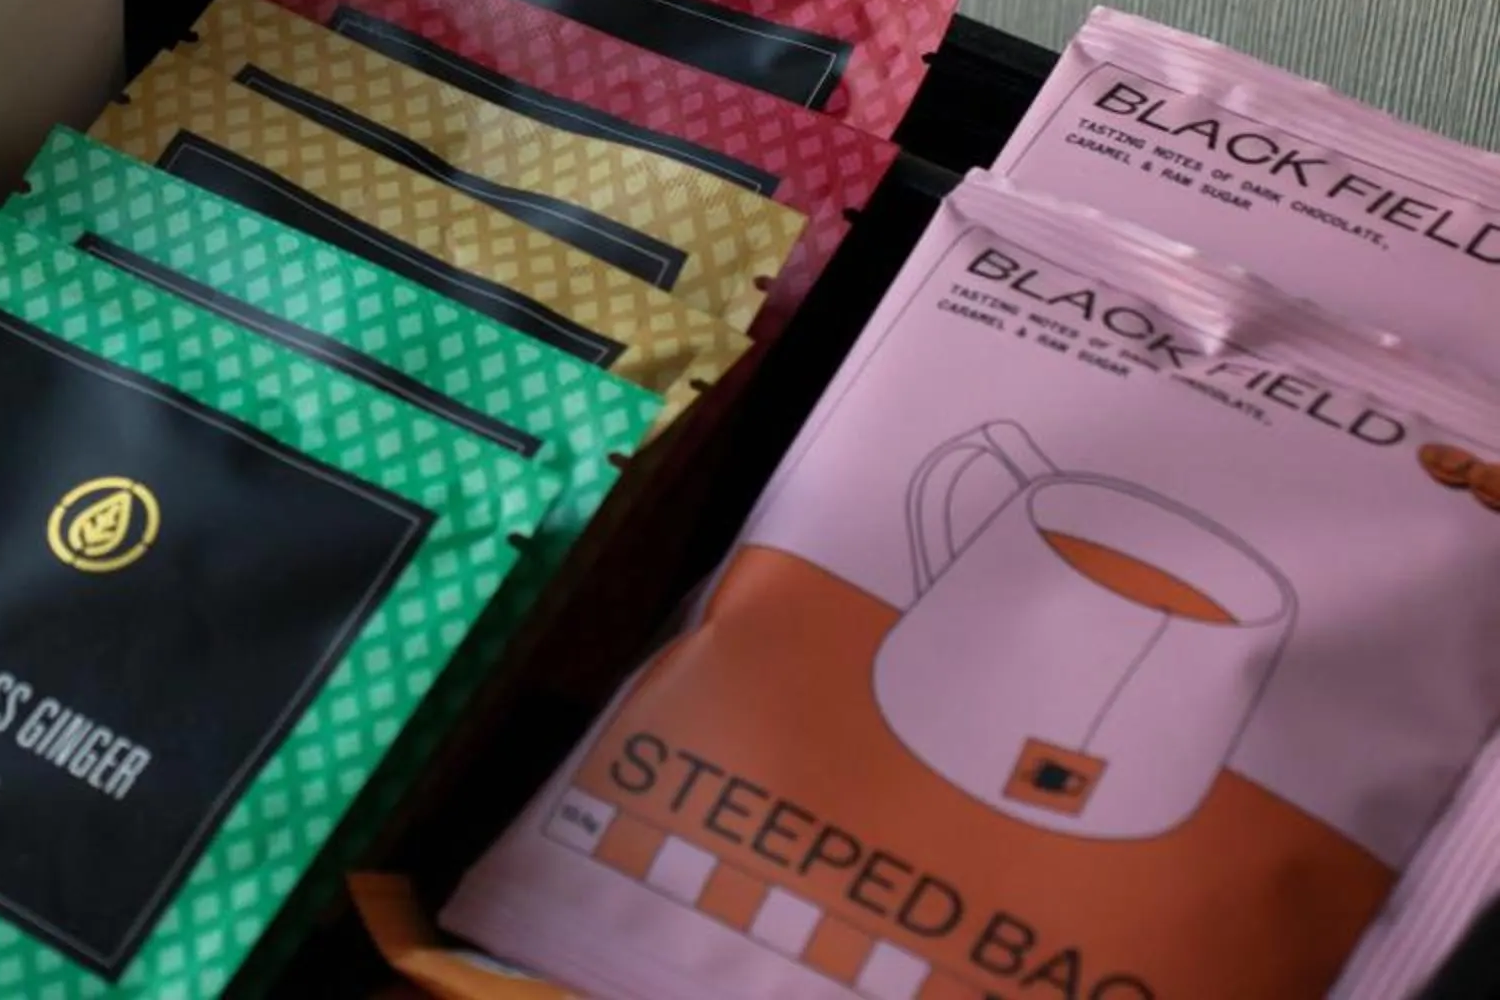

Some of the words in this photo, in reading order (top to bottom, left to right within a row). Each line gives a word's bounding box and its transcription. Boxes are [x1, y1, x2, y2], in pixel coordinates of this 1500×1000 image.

[1065, 133, 1132, 165] CARAMEL
[1140, 161, 1153, 174] &
[1160, 166, 1192, 190] RAW
[1201, 183, 1252, 211] SUGAR
[1077, 118, 1147, 149] TASTING
[1152, 145, 1204, 171] NOTES
[1212, 167, 1233, 182] OF
[1240, 180, 1284, 204] DARK
[1093, 82, 1331, 187] BLACK
[1327, 173, 1500, 266] FIELD
[937, 298, 1005, 331] CARAMEL
[1015, 326, 1028, 339] &
[1036, 333, 1070, 354] RAW
[1077, 349, 1131, 378] SUGAR
[950, 284, 1020, 316] TASTING
[1028, 312, 1080, 339] NOTES
[967, 247, 1203, 369] BLACK
[1206, 362, 1406, 446] FIELD
[16, 699, 153, 800] GINGER
[609, 732, 967, 939] STEEPED
